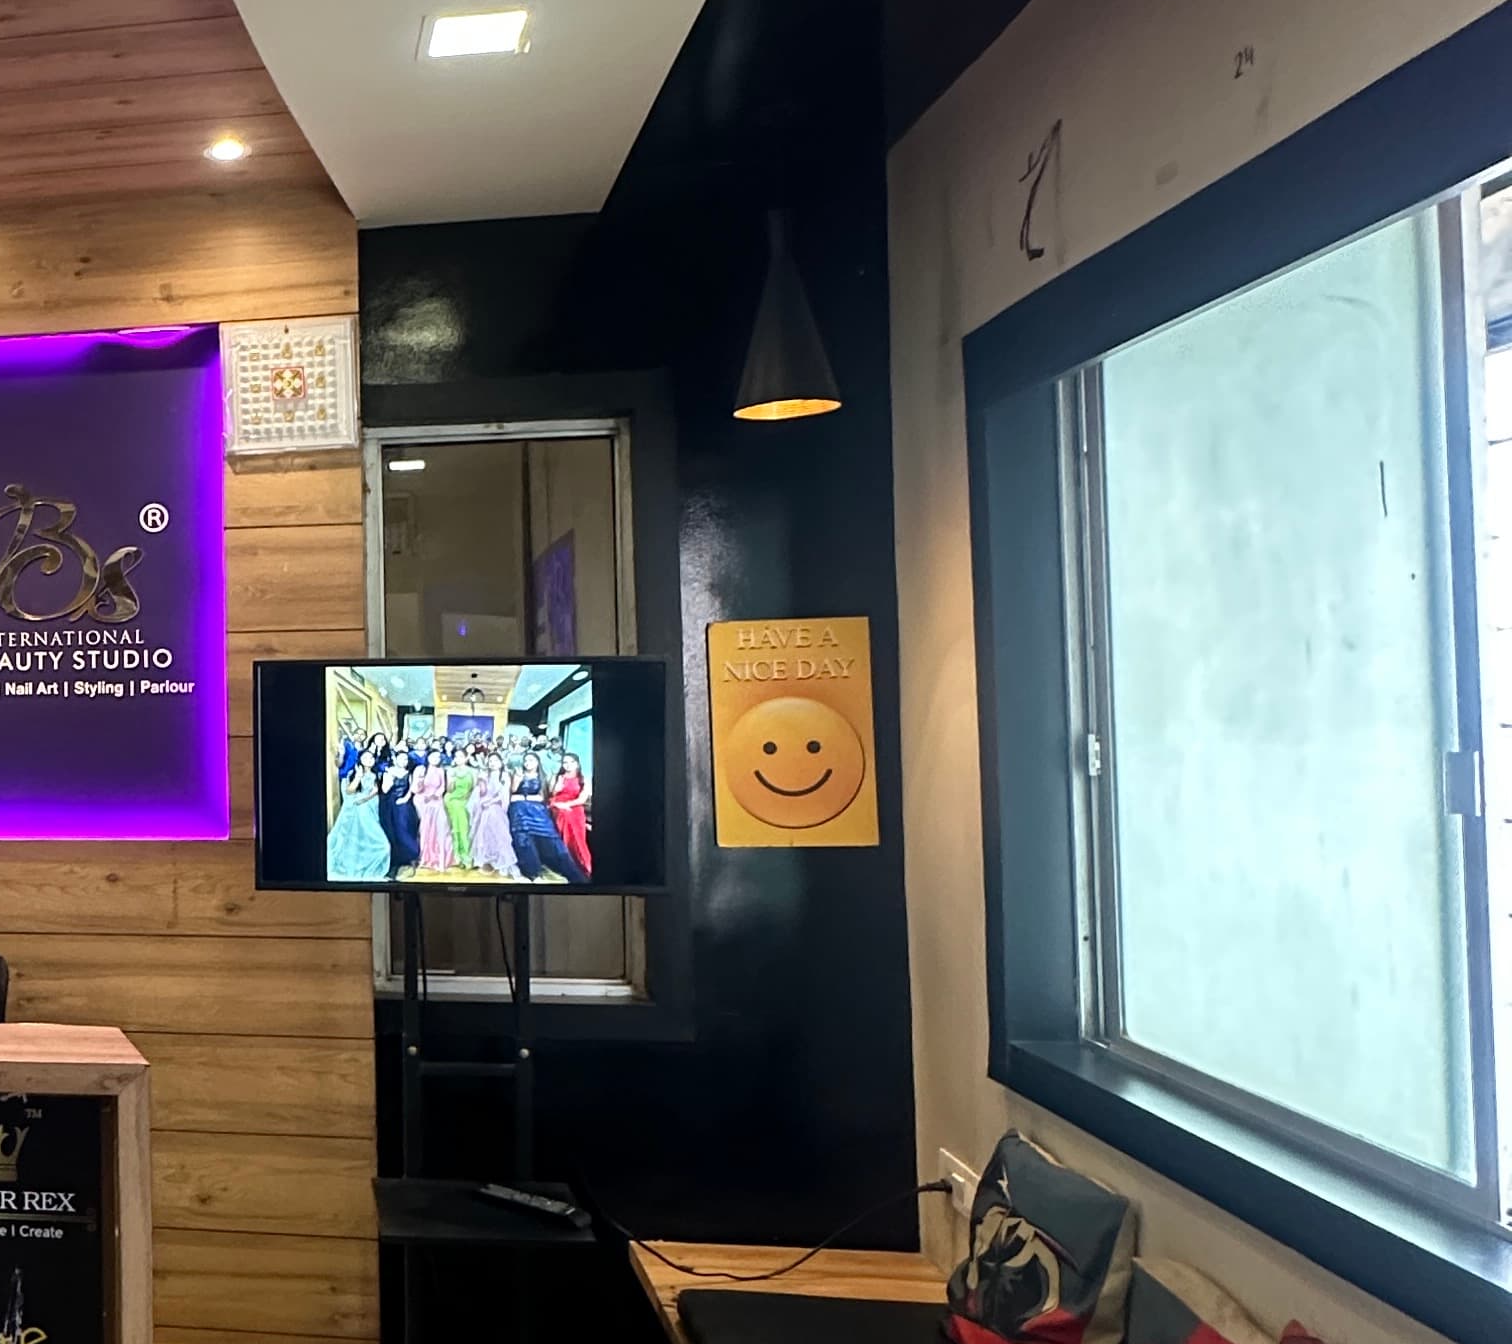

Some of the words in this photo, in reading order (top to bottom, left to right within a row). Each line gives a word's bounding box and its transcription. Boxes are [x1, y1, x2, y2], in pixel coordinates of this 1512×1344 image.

[736, 626, 810, 650] HAVE
[817, 625, 840, 648] A
[72, 648, 173, 671] STUDIO
[723, 660, 788, 683] NICE
[796, 657, 855, 681] DAY
[5, 682, 32, 696] Nail
[37, 681, 59, 695] Art
[74, 680, 124, 696] Styling
[140, 679, 195, 694] Parlour
[23, 1191, 76, 1213] REX
[19, 1225, 64, 1240] Create
